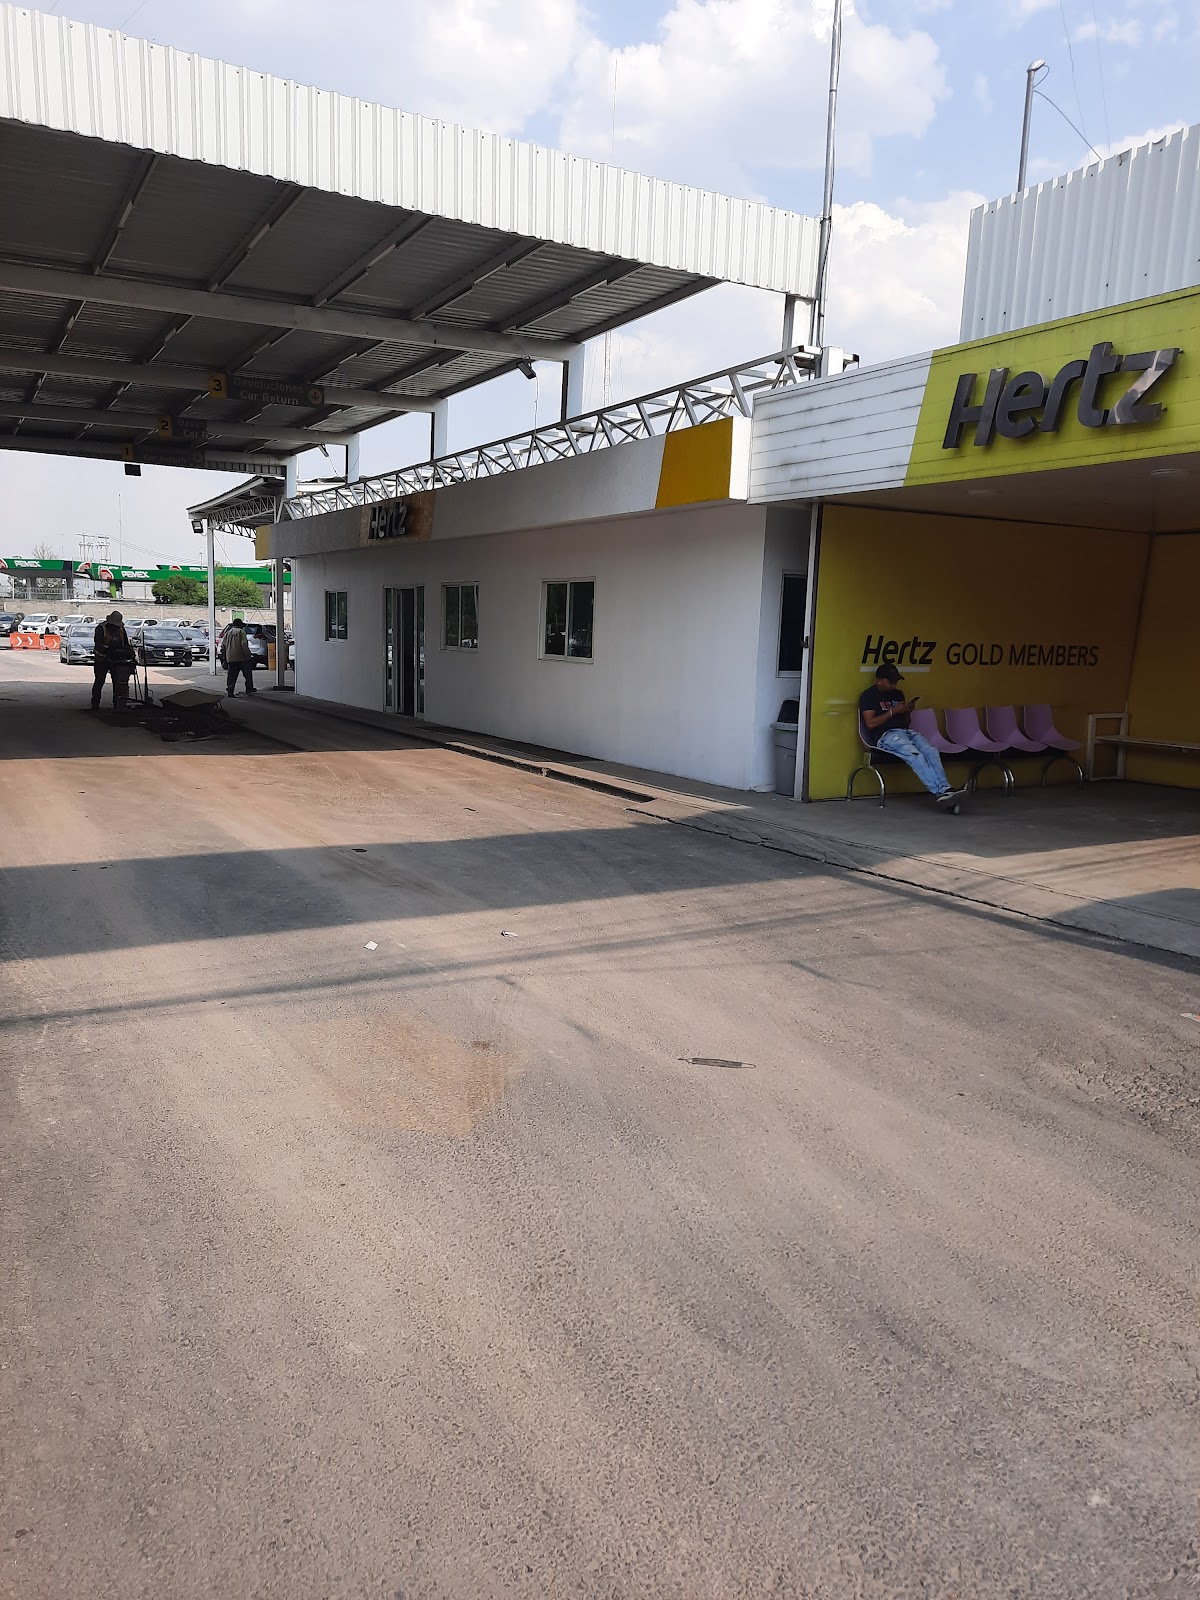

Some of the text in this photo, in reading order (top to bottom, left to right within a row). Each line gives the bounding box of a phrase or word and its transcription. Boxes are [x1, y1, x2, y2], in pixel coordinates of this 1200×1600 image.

[213, 379, 223, 392] 3
[240, 390, 299, 405] Car Return
[942, 341, 1184, 450] Hertz
[160, 420, 169, 431] 2
[368, 501, 408, 540] Hertz
[121, 570, 150, 578] PEMEX
[861, 635, 1100, 667] Hertz GOLD MEMBERS
